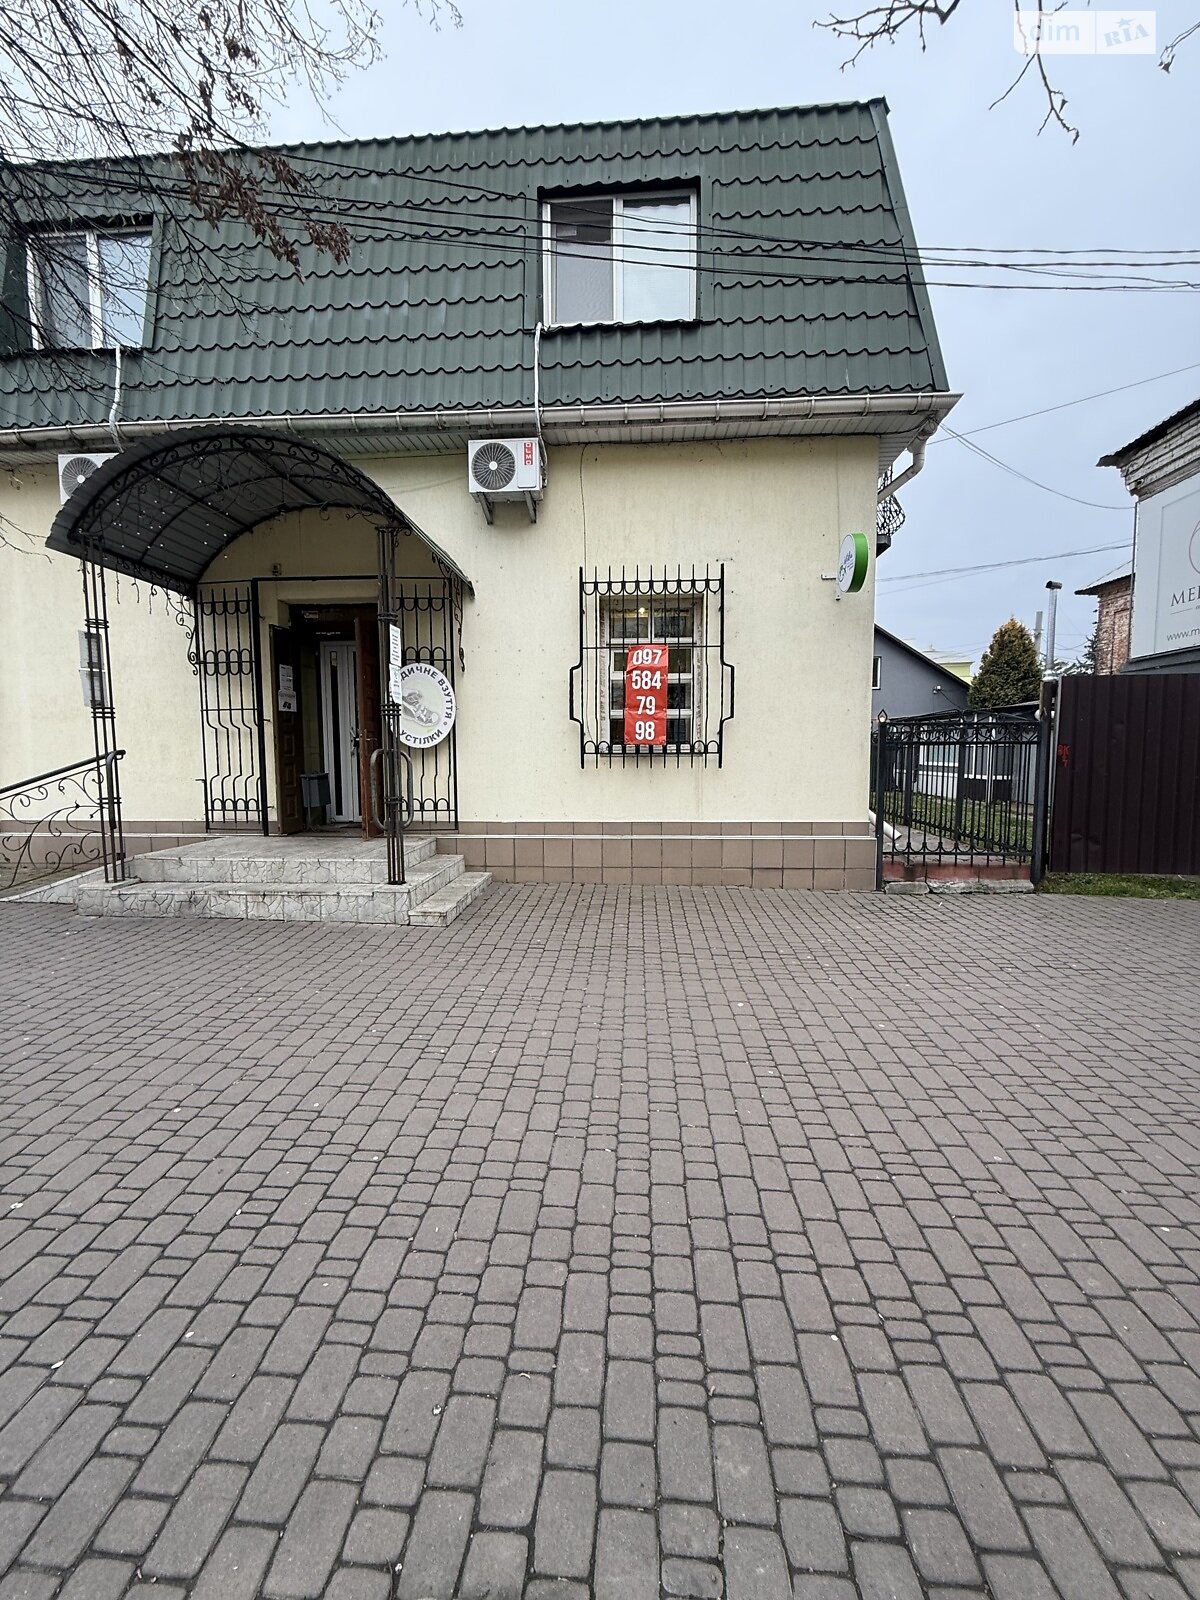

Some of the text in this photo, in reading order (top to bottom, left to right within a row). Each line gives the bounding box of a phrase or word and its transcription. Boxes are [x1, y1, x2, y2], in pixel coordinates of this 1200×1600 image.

[1166, 628, 1200, 641] www.m
[632, 648, 662, 665] 097
[631, 670, 662, 689] 584
[400, 665, 453, 719] ДИЧНЕ ВЗУТТЯ
[636, 695, 656, 715] 79
[635, 721, 655, 740] 98
